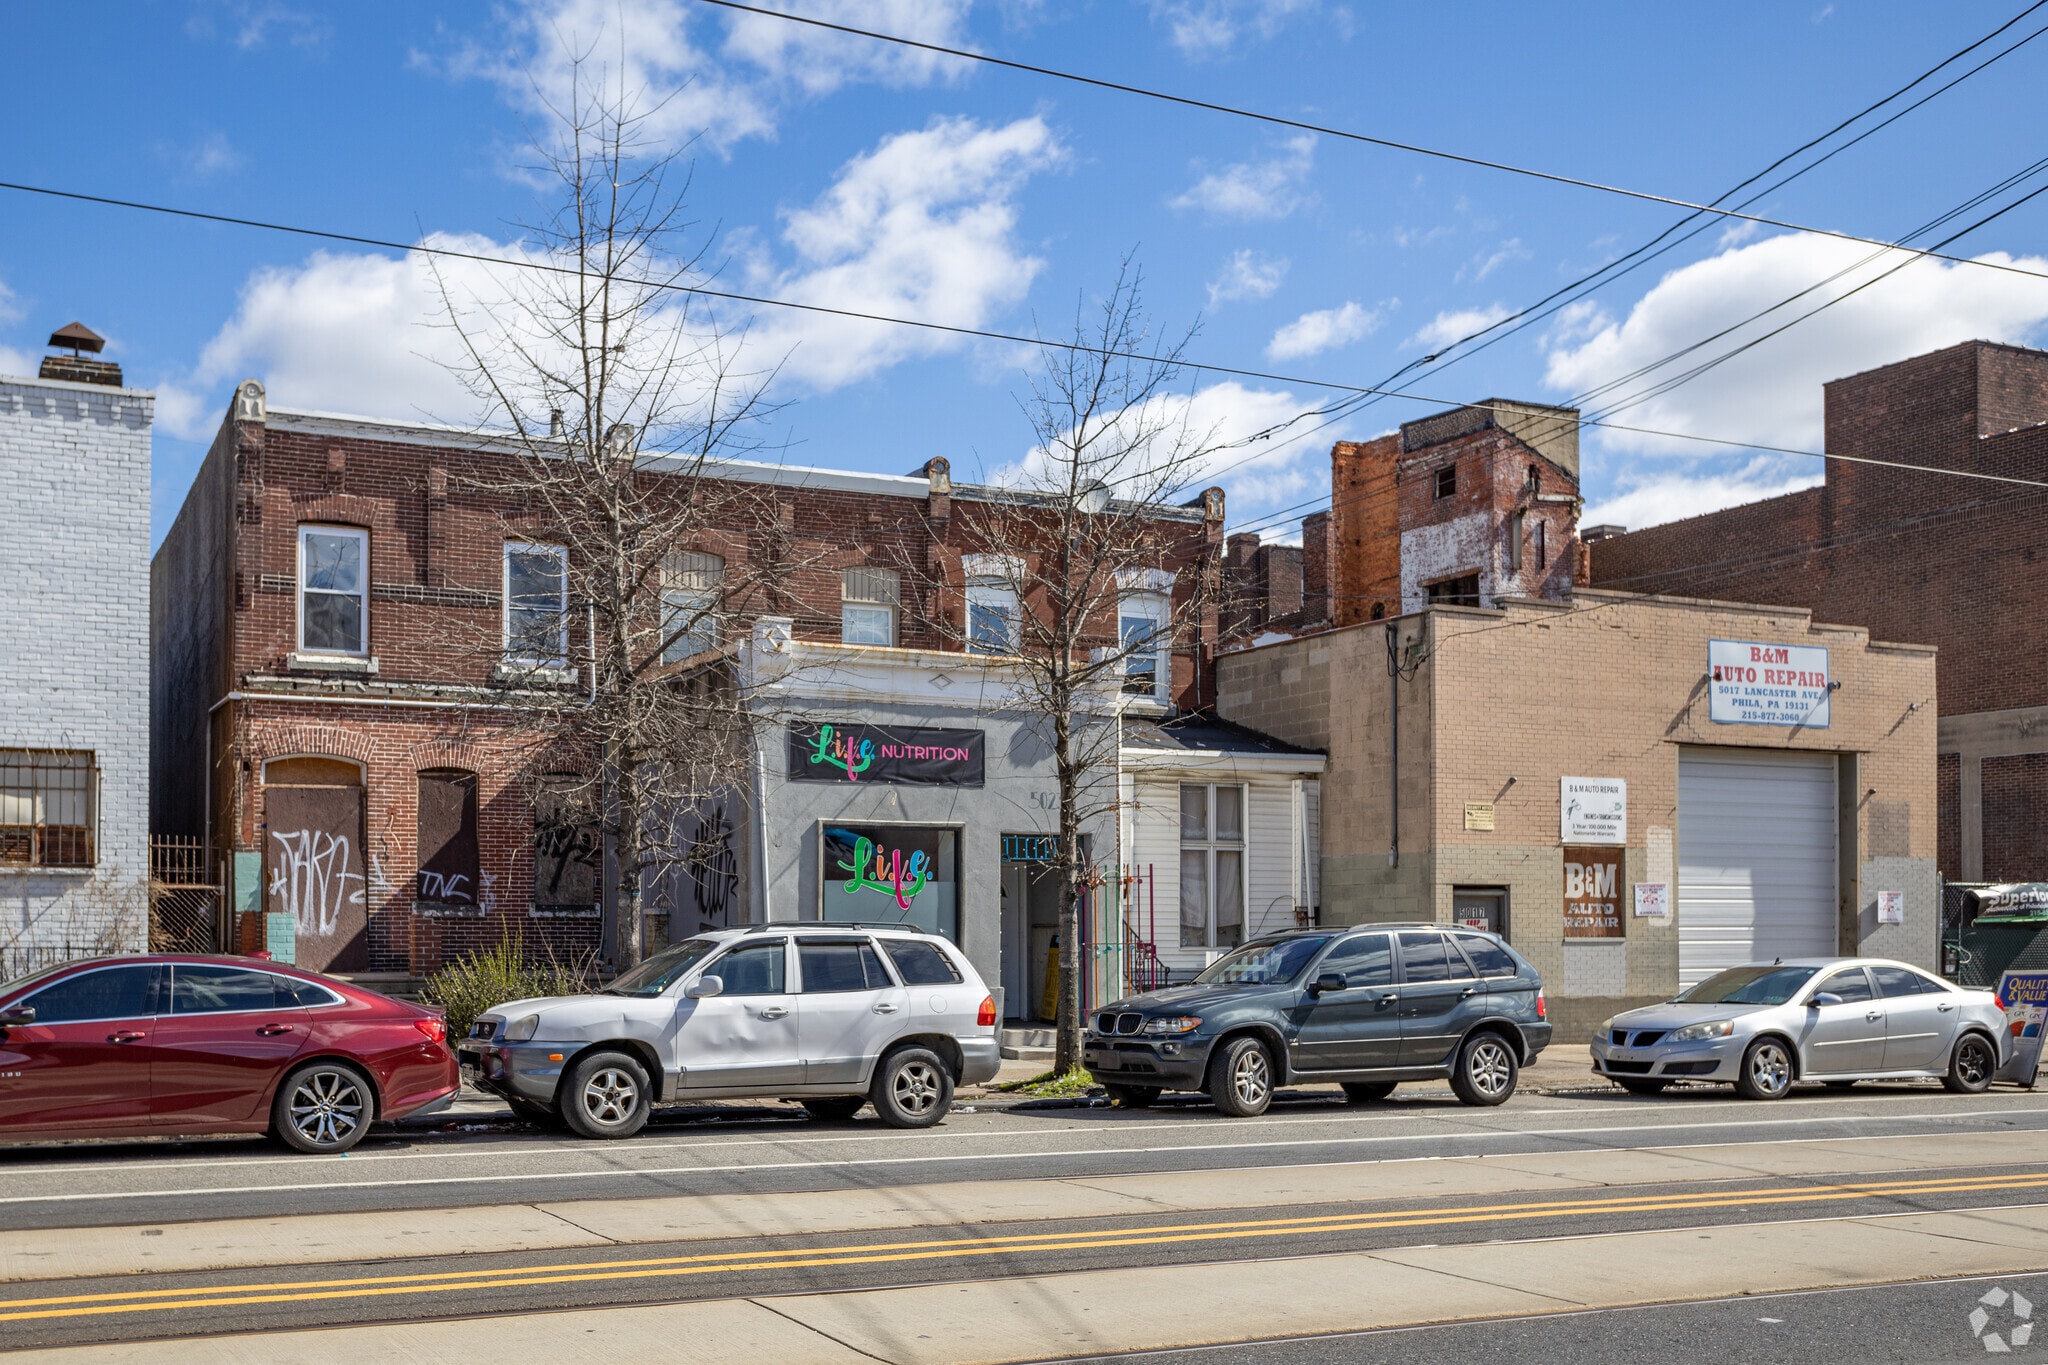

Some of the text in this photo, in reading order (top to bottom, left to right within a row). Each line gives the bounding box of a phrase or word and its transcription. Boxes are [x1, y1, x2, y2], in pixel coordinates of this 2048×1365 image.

[1750, 646, 1789, 665] B&M
[1713, 665, 1826, 688] AUTO REPAIR
[1718, 685, 1739, 695] 5017
[1744, 686, 1797, 699] LANCASTER
[1767, 701, 1779, 709] PA
[1785, 702, 1809, 711] 19131
[1741, 711, 1800, 722] 215-877-3060
[881, 744, 969, 761] NUTRITION
[1585, 785, 1599, 793] AUTO
[1600, 786, 1619, 794] REPAIR
[1028, 791, 1061, 810] 502
[1564, 862, 1618, 899] B&M
[1567, 902, 1615, 915] AUTO
[1563, 916, 1619, 928] REPAIR
